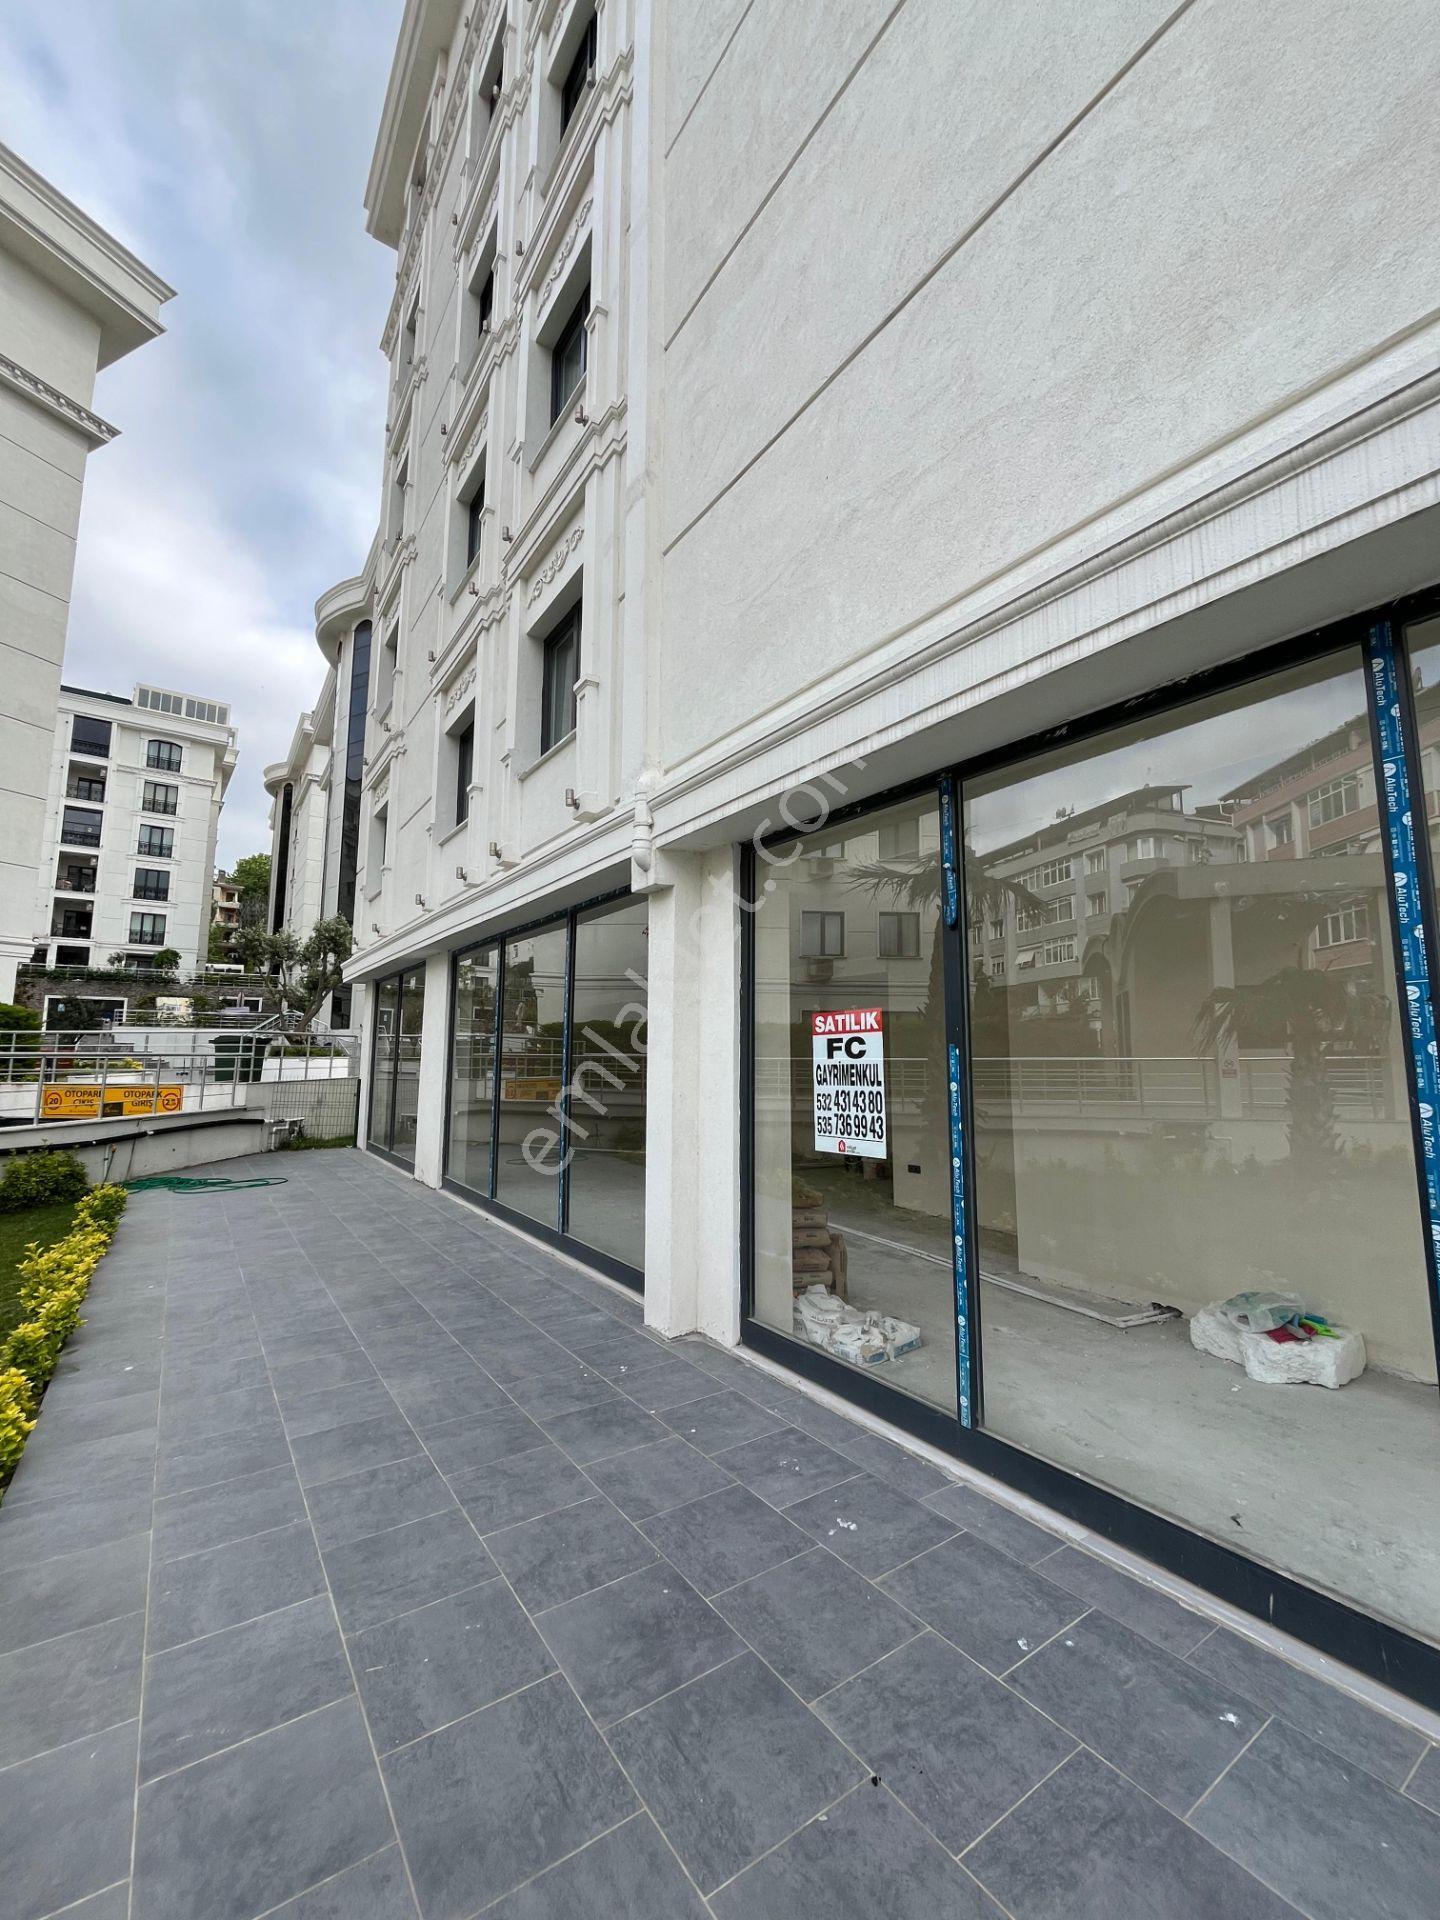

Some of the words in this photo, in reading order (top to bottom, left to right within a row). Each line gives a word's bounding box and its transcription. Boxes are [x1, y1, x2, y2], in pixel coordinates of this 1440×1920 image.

[1373, 671, 1386, 707] AluTech
[1385, 777, 1398, 813] AluTech
[1396, 887, 1409, 924] AluTech
[814, 1011, 879, 1033] SATILIK
[1409, 1001, 1422, 1040] AluTech
[826, 1036, 867, 1060] FC
[815, 1060, 882, 1087] GAYRİMENKUL
[49, 1097, 59, 1105] 20
[816, 1092, 832, 1112] 532
[868, 1090, 883, 1114] 80
[817, 1115, 832, 1135] 535
[834, 1113, 852, 1137] 736
[853, 1115, 868, 1138] 99
[869, 1116, 884, 1140] 43
[1421, 1119, 1437, 1159] AluTech
